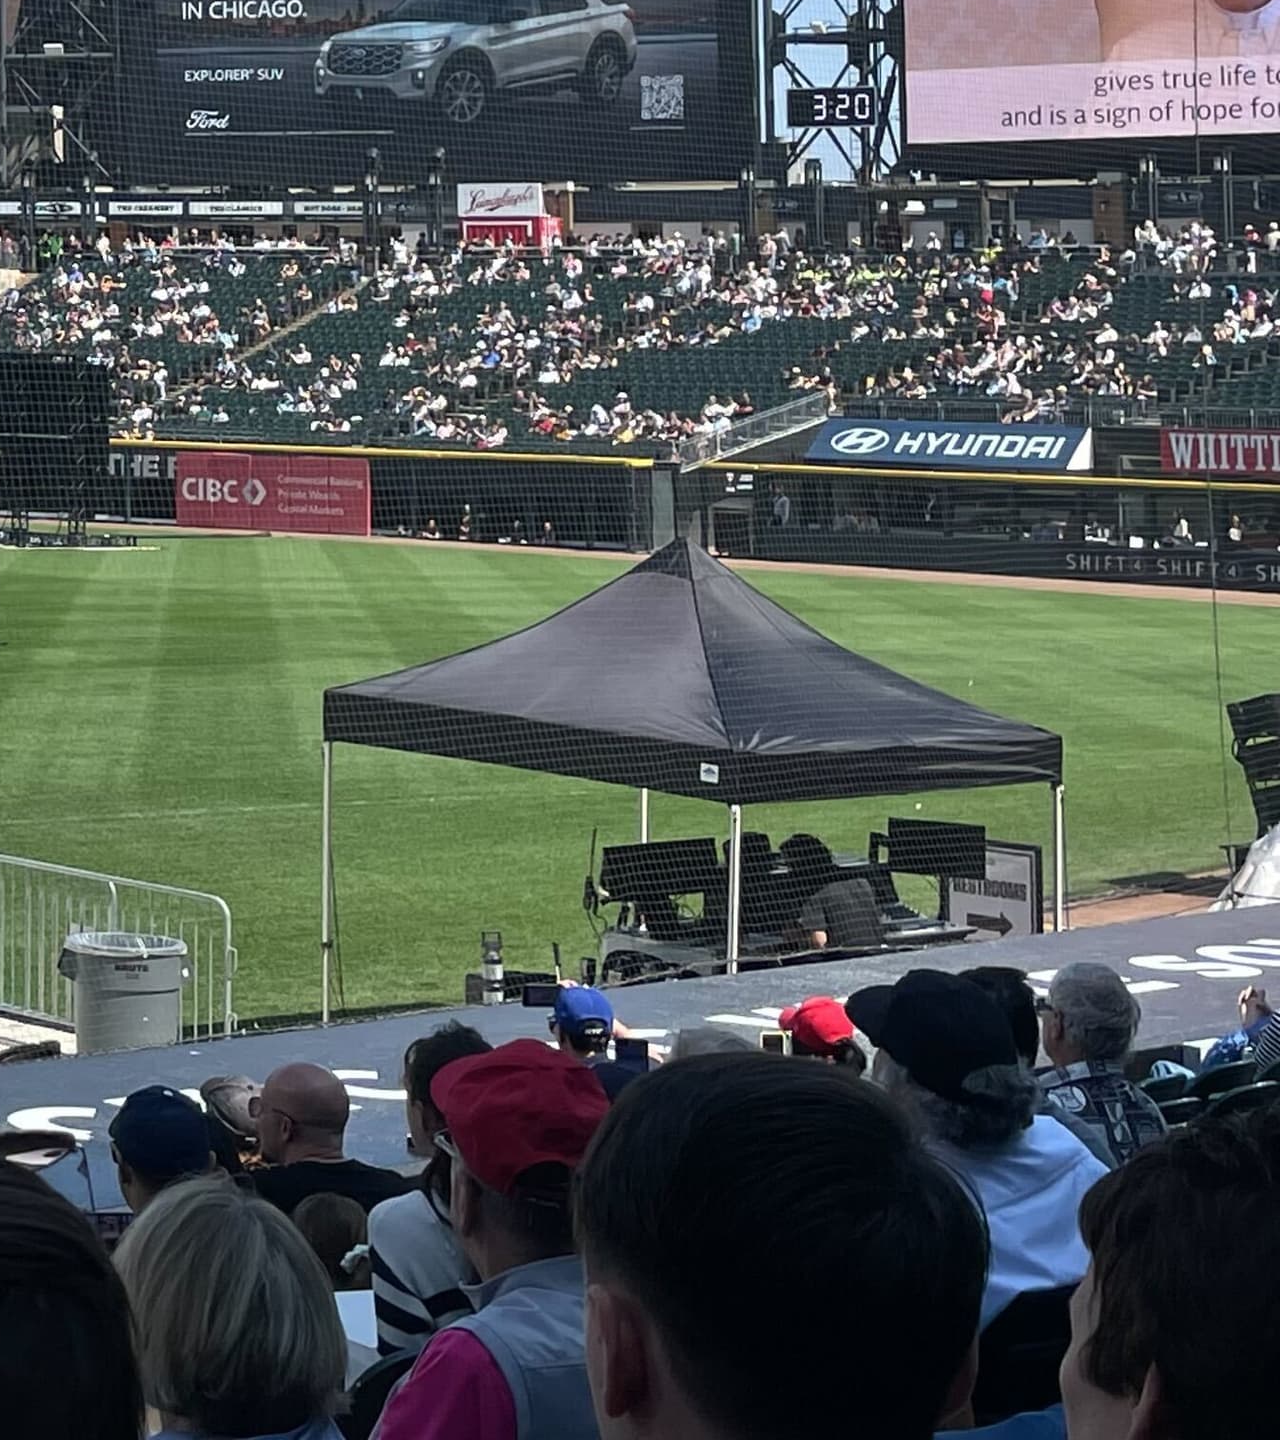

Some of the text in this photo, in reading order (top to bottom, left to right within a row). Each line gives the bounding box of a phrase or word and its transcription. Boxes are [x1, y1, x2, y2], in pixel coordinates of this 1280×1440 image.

[181, 0, 308, 20] IN CHICAGO.
[257, 67, 284, 81] SUV
[1094, 71, 1154, 97] gives
[1162, 69, 1212, 90] true
[1220, 64, 1256, 86] life
[186, 109, 231, 129] Ford
[813, 94, 870, 120] 3:20
[1001, 95, 1280, 129] and is a sign of hope fo
[893, 431, 1067, 459] HYUNDAI
[182, 476, 238, 504] CIBC
